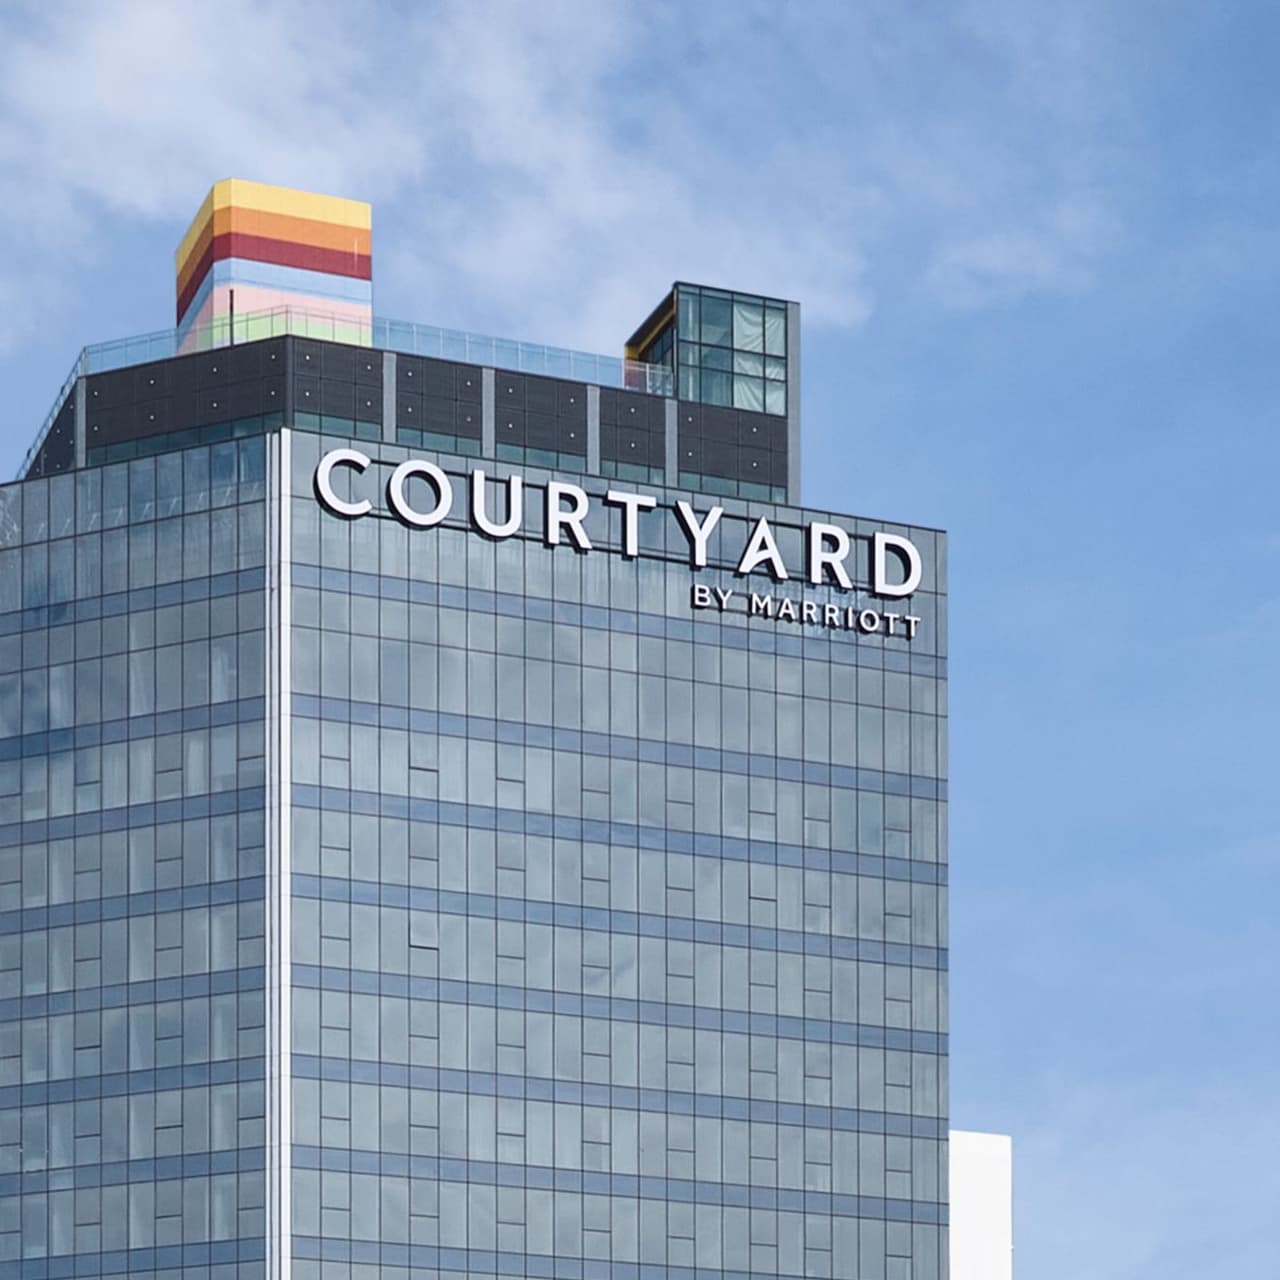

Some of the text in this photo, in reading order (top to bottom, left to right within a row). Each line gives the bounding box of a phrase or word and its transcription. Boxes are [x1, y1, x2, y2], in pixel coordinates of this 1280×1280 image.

[316, 448, 923, 597] COURTYARD
[694, 583, 922, 638] BY MARRIOTT
